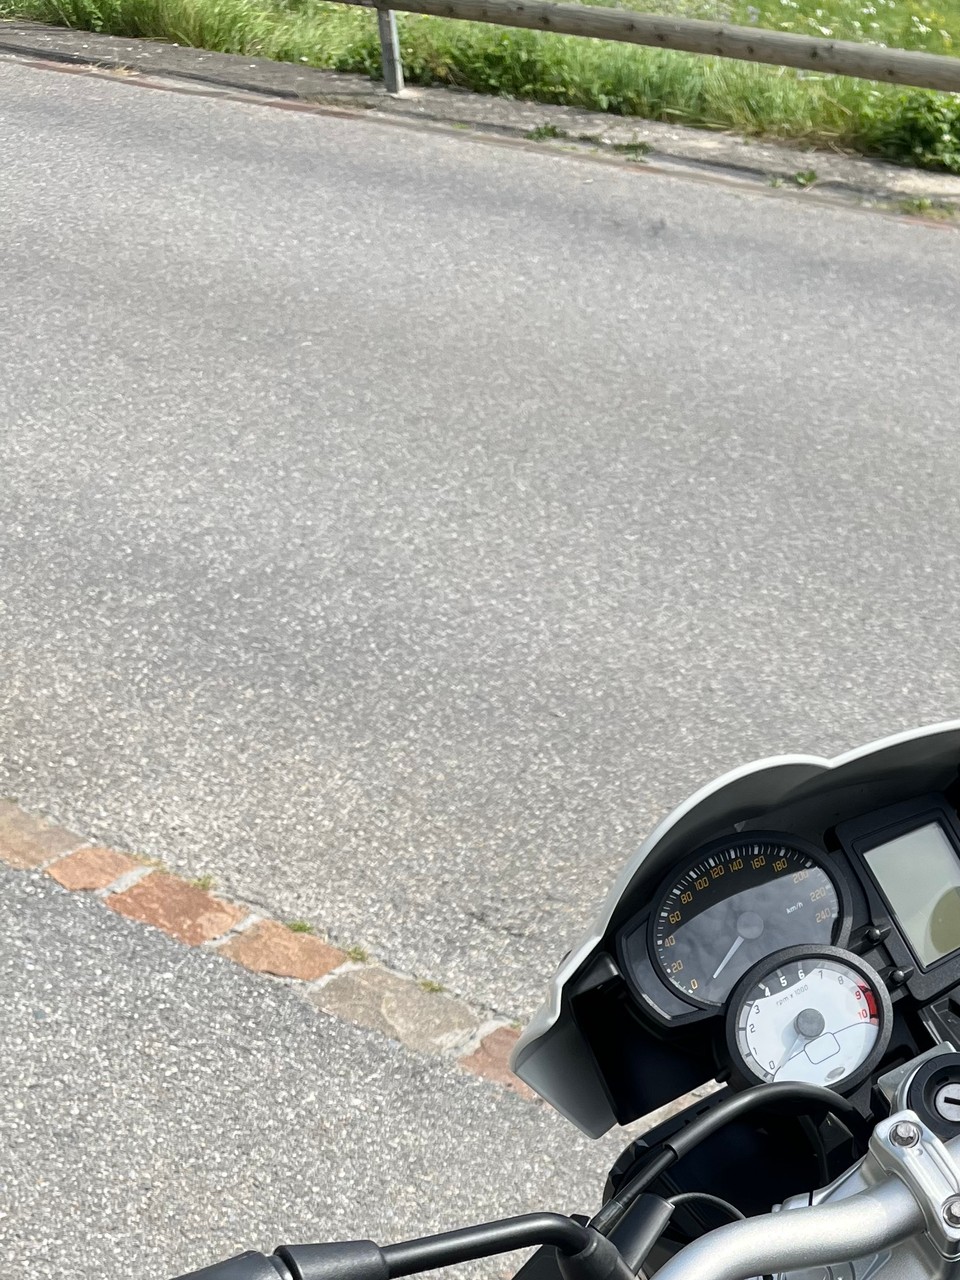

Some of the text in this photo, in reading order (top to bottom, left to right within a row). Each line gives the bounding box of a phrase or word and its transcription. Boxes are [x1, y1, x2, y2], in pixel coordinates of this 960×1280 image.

[729, 859, 744, 872] 140
[751, 856, 766, 870] 160
[773, 858, 788, 873] 180
[710, 865, 725, 879] 120
[793, 869, 809, 884] 200
[694, 877, 709, 891] 100
[681, 891, 693, 905] 80
[810, 888, 826, 902] 220
[786, 902, 804, 915] km/h
[668, 911, 682, 924] 60
[815, 908, 832, 923] 240
[664, 935, 676, 948] 40
[671, 960, 684, 973] 20
[798, 970, 805, 979] 6
[818, 971, 824, 979] 7
[838, 976, 844, 985] 8
[690, 978, 698, 990] 0
[780, 976, 788, 987] 5
[764, 987, 771, 997] 4
[775, 996, 789, 1006] rpm
[794, 984, 809, 997] 1000
[855, 991, 862, 1000] 9
[754, 1005, 761, 1014] 3
[858, 1009, 868, 1020] 10
[749, 1024, 756, 1033] 2
[769, 1060, 776, 1070] 0
